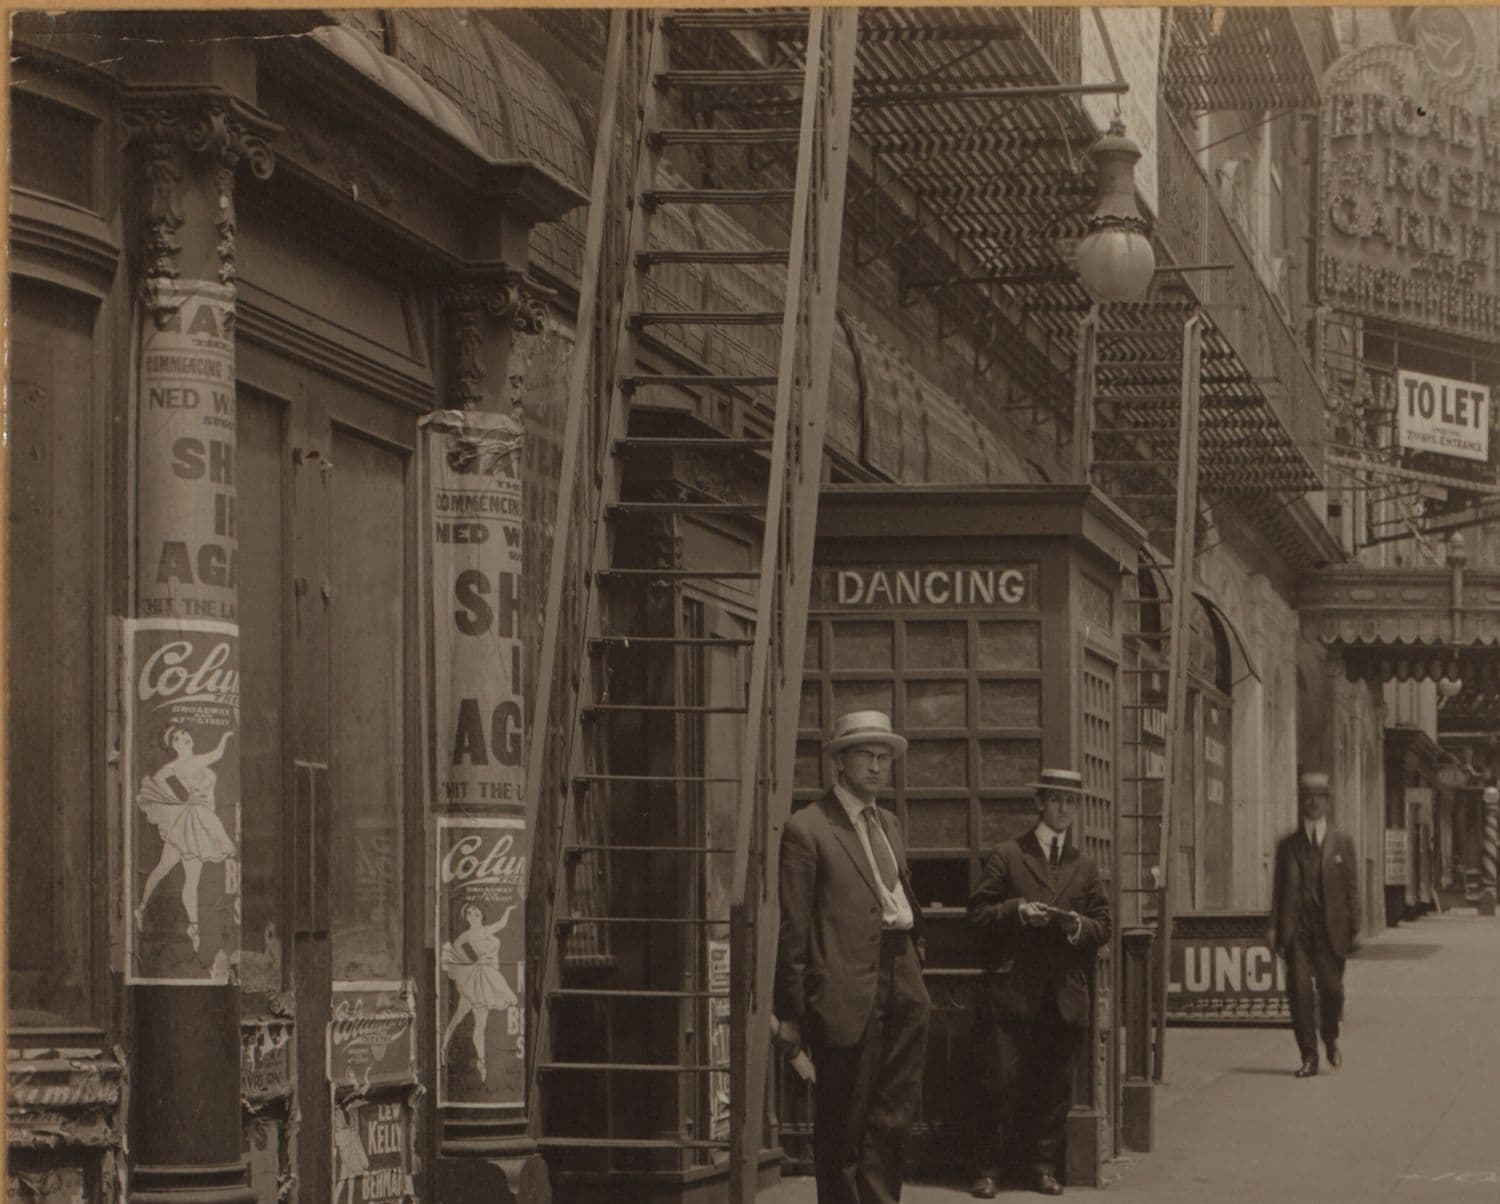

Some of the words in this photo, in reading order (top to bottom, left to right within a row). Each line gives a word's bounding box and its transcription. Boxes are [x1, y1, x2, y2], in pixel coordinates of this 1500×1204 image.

[146, 355, 222, 377] COMMENCING
[149, 387, 200, 409] NED
[1404, 377, 1435, 419] TO
[1441, 384, 1485, 430] LET
[436, 522, 490, 545] NED
[156, 541, 235, 590] AG
[837, 570, 1024, 605] DANCING
[182, 599, 216, 618] THE
[478, 782, 512, 799] THE
[377, 1105, 401, 1122] LEW
[367, 1120, 402, 1156] KELLY
